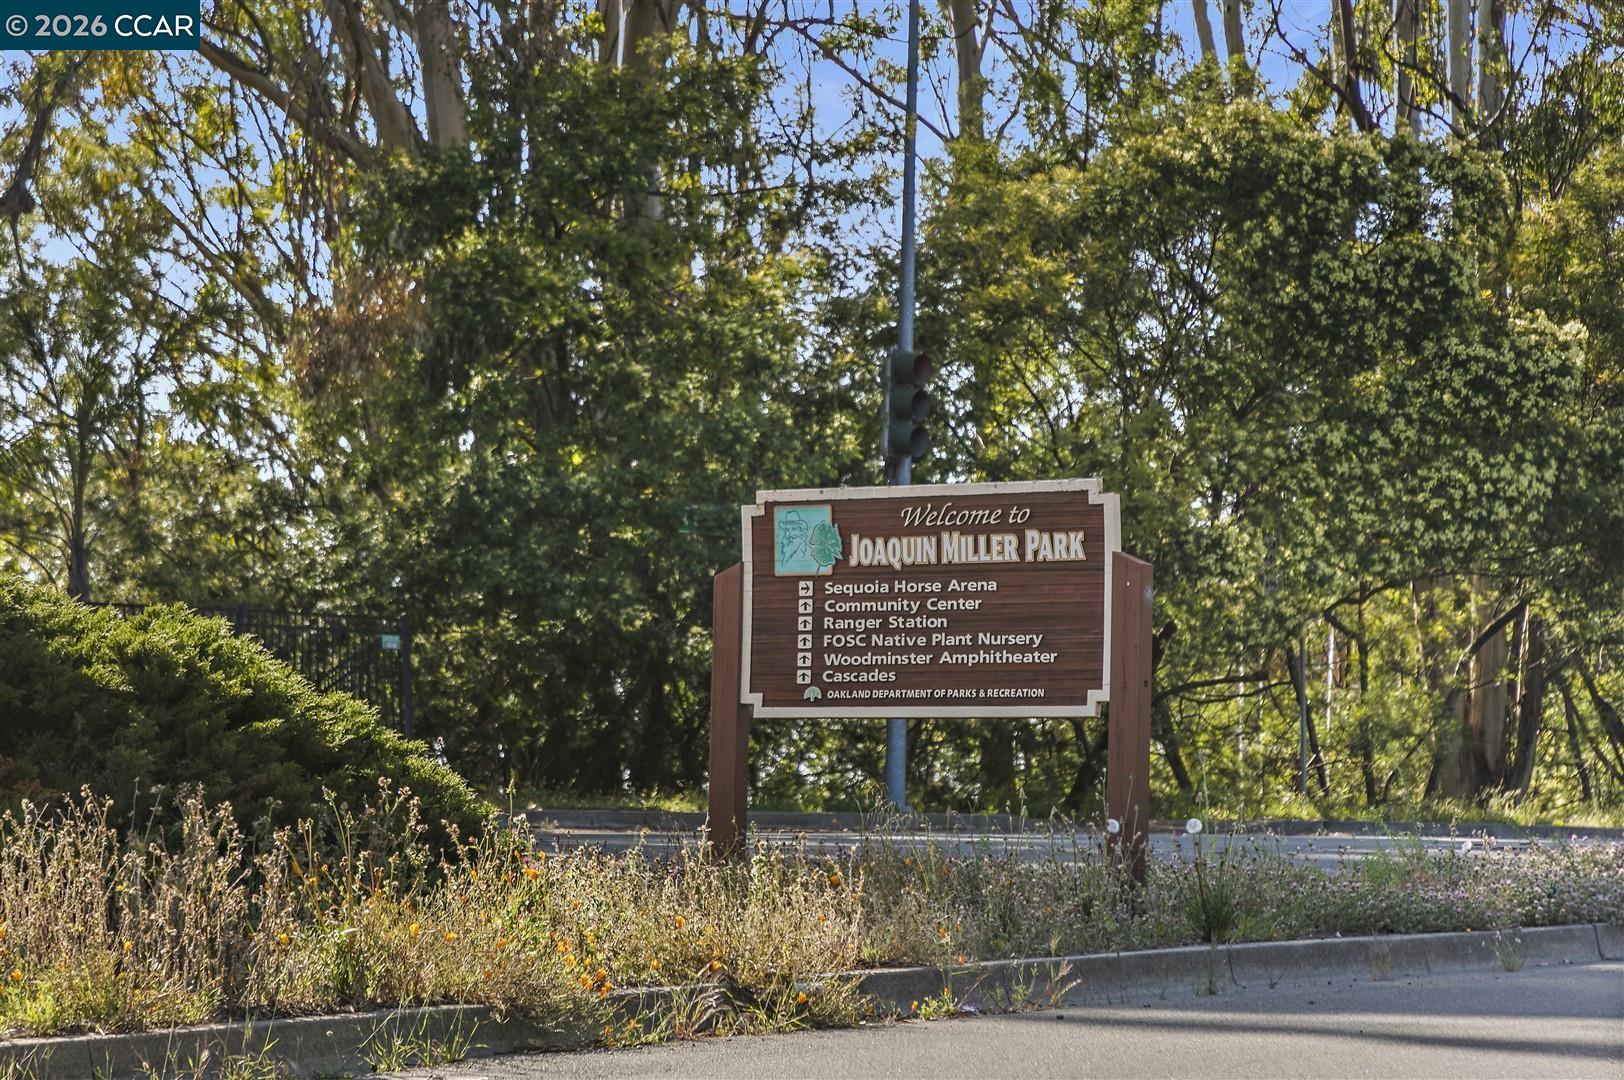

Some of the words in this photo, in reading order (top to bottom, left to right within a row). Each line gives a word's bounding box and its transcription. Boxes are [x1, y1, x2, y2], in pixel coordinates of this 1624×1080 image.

[900, 502, 1001, 528] Welcome
[1008, 506, 1031, 524] to
[849, 532, 938, 571] JOAQUIN
[941, 530, 1020, 564] MILLER
[1024, 528, 1087, 562] PARK
[824, 581, 889, 597] Sequoia
[894, 580, 942, 594] Horse
[947, 579, 998, 592] Arena
[824, 597, 920, 614] Community
[926, 597, 982, 611] Center
[823, 616, 883, 632] Ranger
[888, 615, 948, 629] Station
[823, 634, 867, 648] FOSC
[871, 632, 927, 647] Native
[931, 632, 973, 647] Plant
[978, 632, 1043, 648] Nursery
[824, 652, 933, 666] Woodminster
[939, 650, 1058, 667] Amphitheater
[822, 668, 897, 683] Cascades
[827, 689, 871, 699] OAKLAND
[872, 688, 932, 699] DEPARTMENT
[933, 688, 946, 698] OF
[947, 688, 977, 698] PARKS
[978, 688, 986, 698] &
[987, 687, 1045, 698] RECREATION
